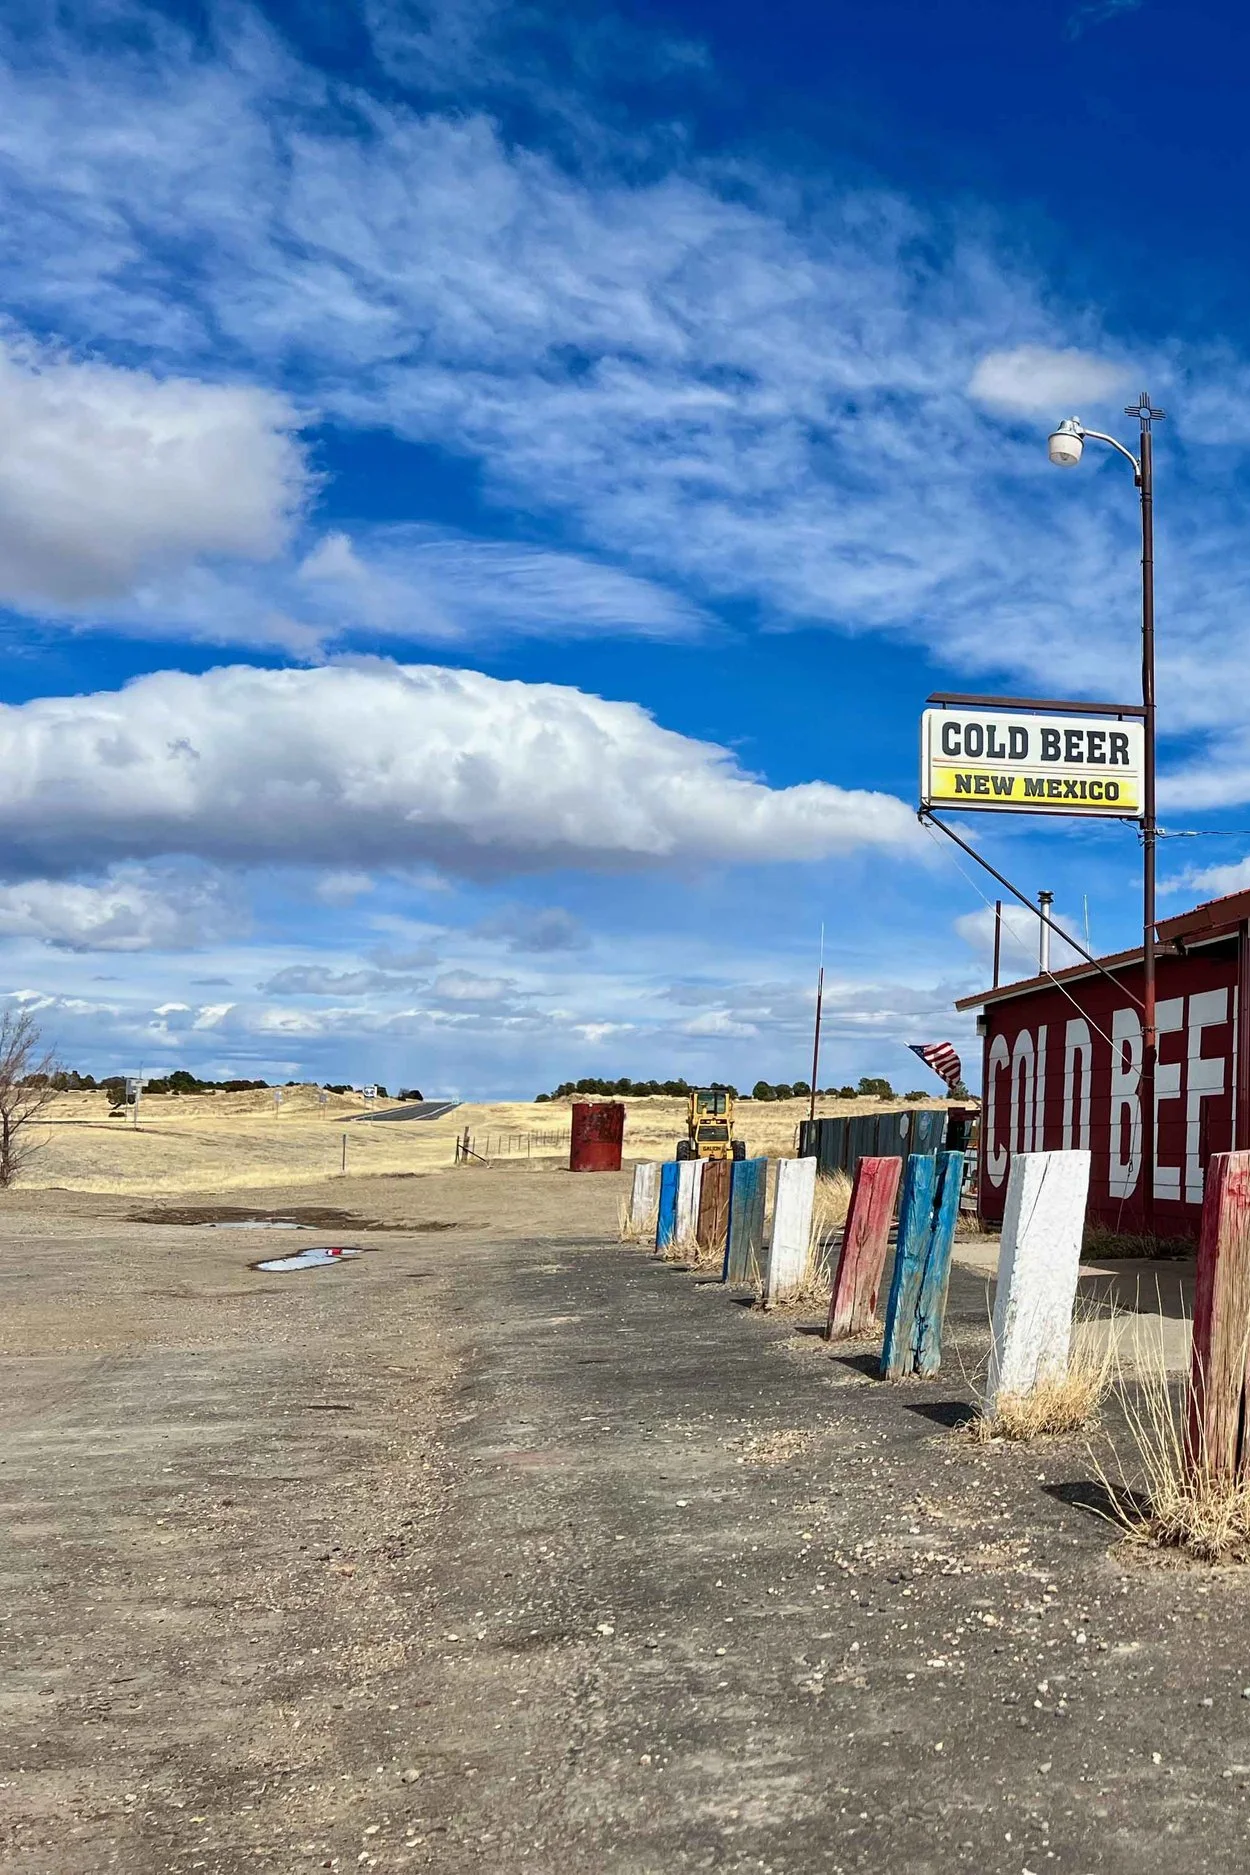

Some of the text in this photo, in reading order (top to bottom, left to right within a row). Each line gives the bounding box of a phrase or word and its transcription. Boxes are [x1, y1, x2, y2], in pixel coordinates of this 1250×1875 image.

[941, 721, 1129, 765] COLD BEER
[955, 774, 1119, 801] NEW MEXICO
[1109, 985, 1239, 1204] BEE
